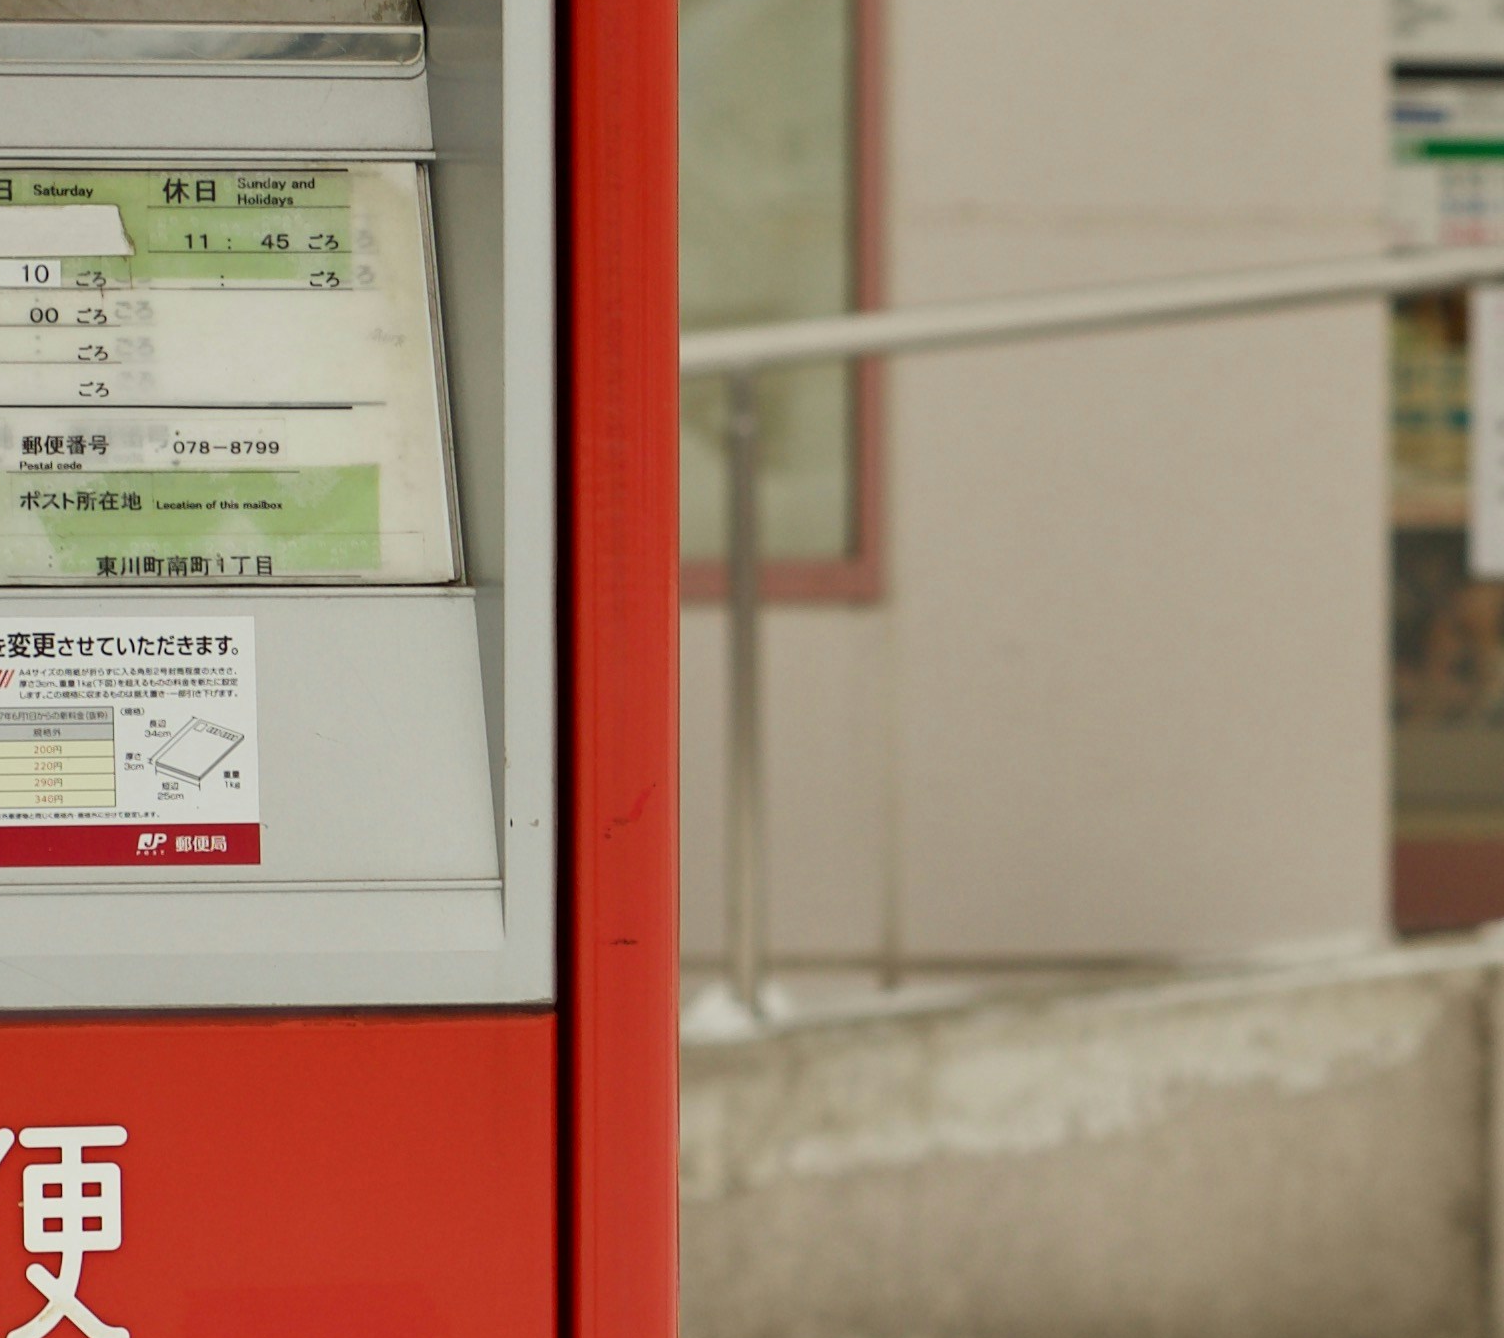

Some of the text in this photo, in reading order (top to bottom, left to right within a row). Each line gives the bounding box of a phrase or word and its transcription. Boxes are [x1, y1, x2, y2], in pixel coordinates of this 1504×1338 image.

[33, 184, 94, 198] Saturday
[163, 178, 216, 204] 休日
[237, 177, 315, 190] Sunday and
[237, 194, 294, 206] Holidays
[308, 234, 340, 250] ごろ
[75, 270, 107, 287] ごろ
[309, 271, 340, 287] ごろ
[76, 308, 108, 324] ごろ
[78, 345, 109, 361] ごろ
[78, 381, 109, 397] ごろ
[21, 435, 110, 456] 郵便番号
[19, 461, 53, 471] Postal
[19, 491, 143, 512] ポスト所在地
[206, 500, 217, 511] of
[220, 500, 240, 511] this
[243, 500, 283, 511] mailbox
[175, 835, 227, 853] 郵便局
